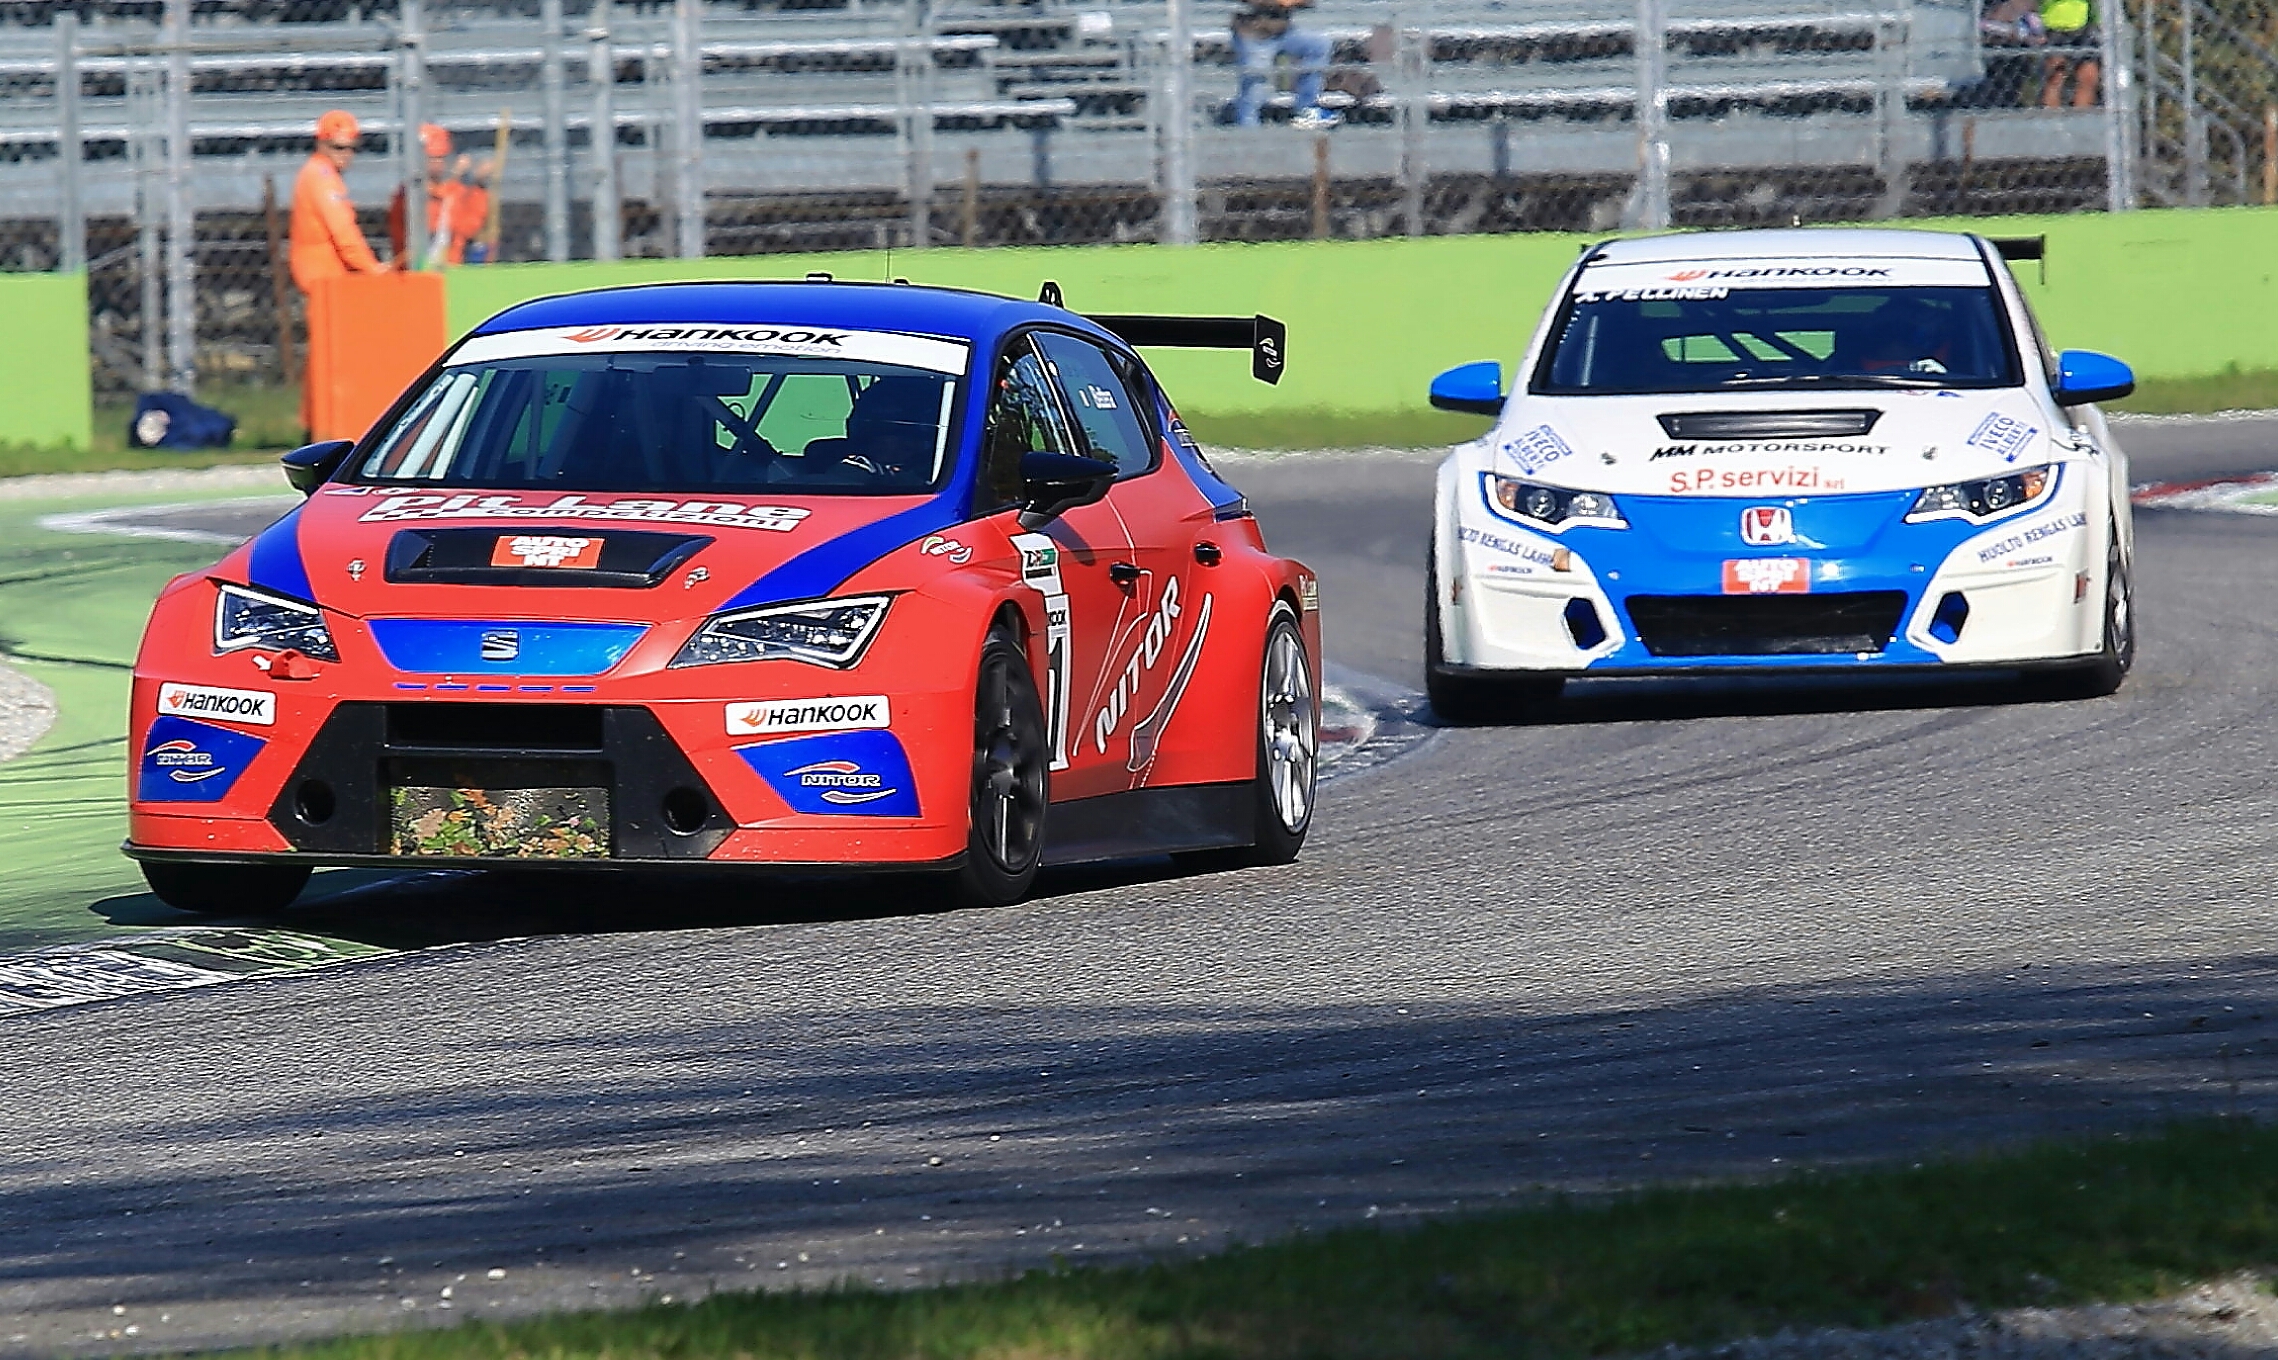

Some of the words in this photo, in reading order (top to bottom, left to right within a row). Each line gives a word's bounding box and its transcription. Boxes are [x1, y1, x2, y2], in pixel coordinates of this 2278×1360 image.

[1604, 286, 1731, 301] PELLINEN
[650, 341, 739, 350] driving
[739, 343, 842, 354] emotion
[1702, 443, 1891, 455] MOTORSPORT
[1721, 466, 1820, 488] servizi
[357, 493, 524, 522] Pit
[547, 494, 813, 522] Lane
[509, 536, 591, 549] AUTO
[523, 555, 563, 568] NT
[1095, 575, 1182, 755] NITOR
[800, 773, 881, 787] NITOR
